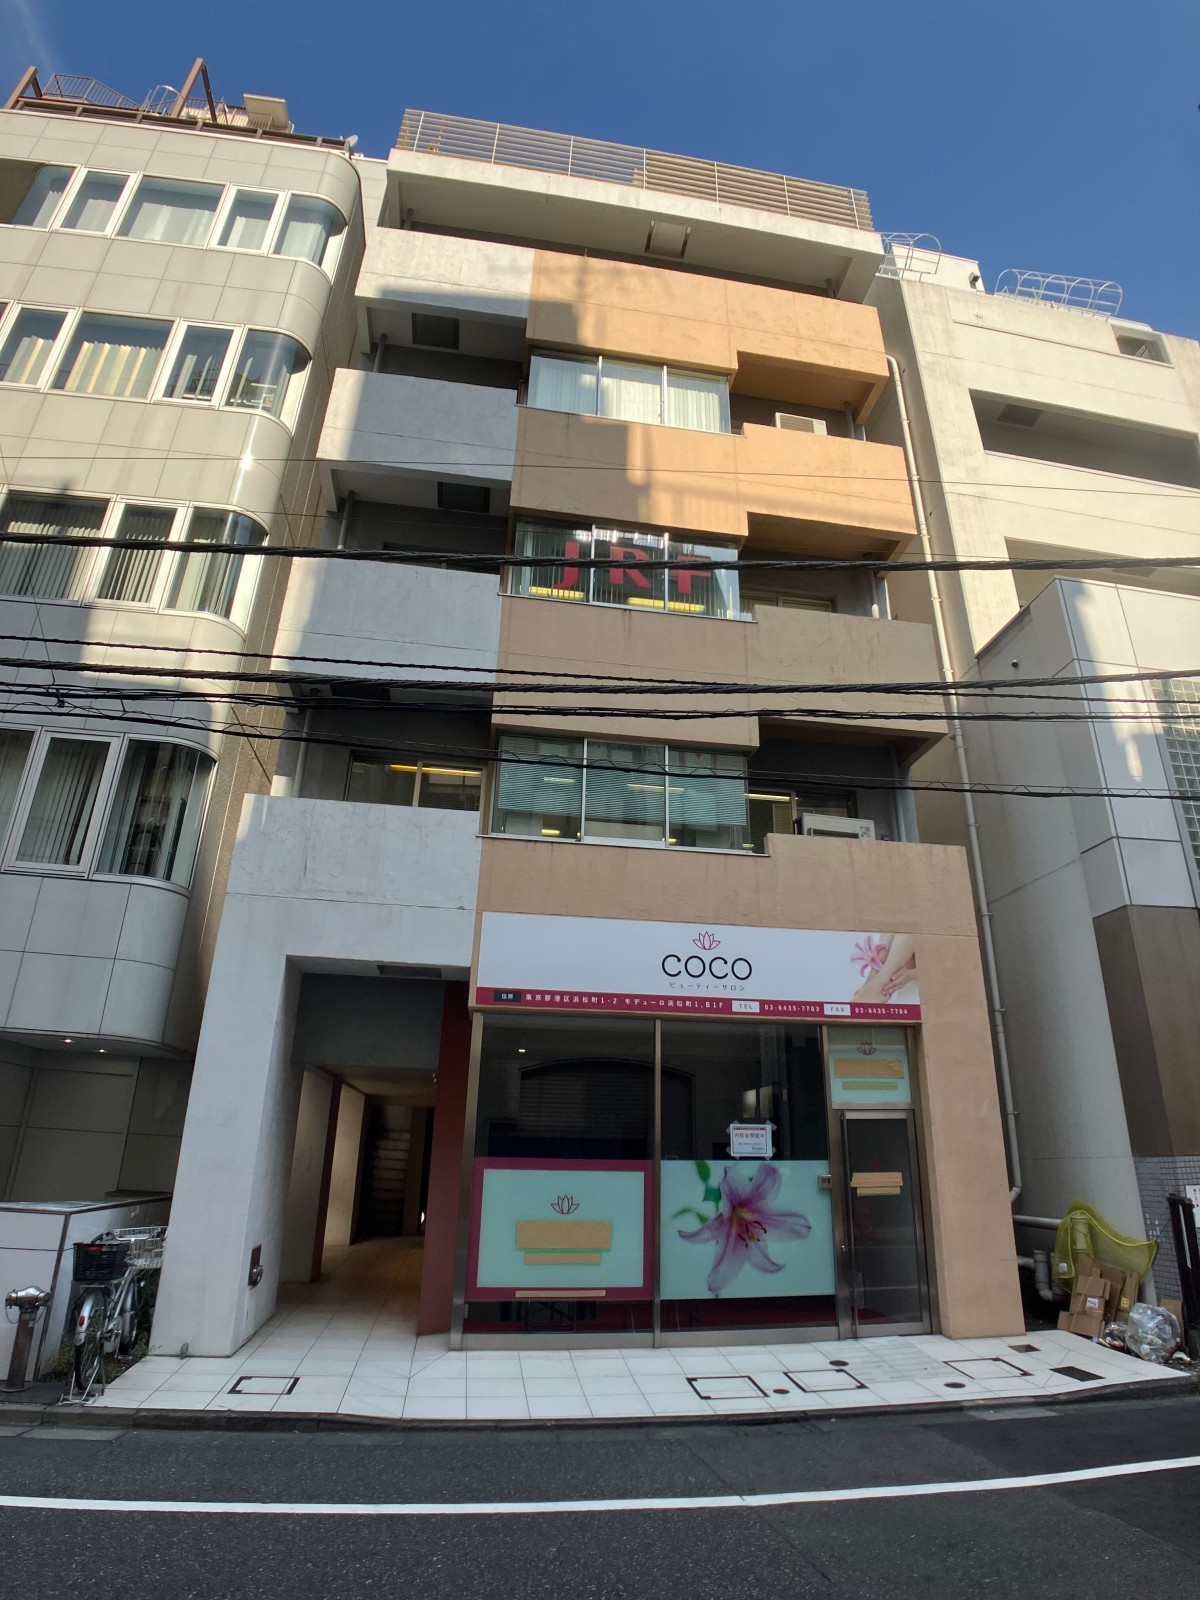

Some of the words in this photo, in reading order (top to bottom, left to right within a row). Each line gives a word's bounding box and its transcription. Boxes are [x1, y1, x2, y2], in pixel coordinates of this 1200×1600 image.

[554, 541, 711, 594] JRF
[661, 953, 753, 981] COCO
[669, 981, 745, 992] ビューティーサロン
[764, 1004, 820, 1012] 03-6435-7703
[855, 1007, 908, 1015] 03-6435-7704
